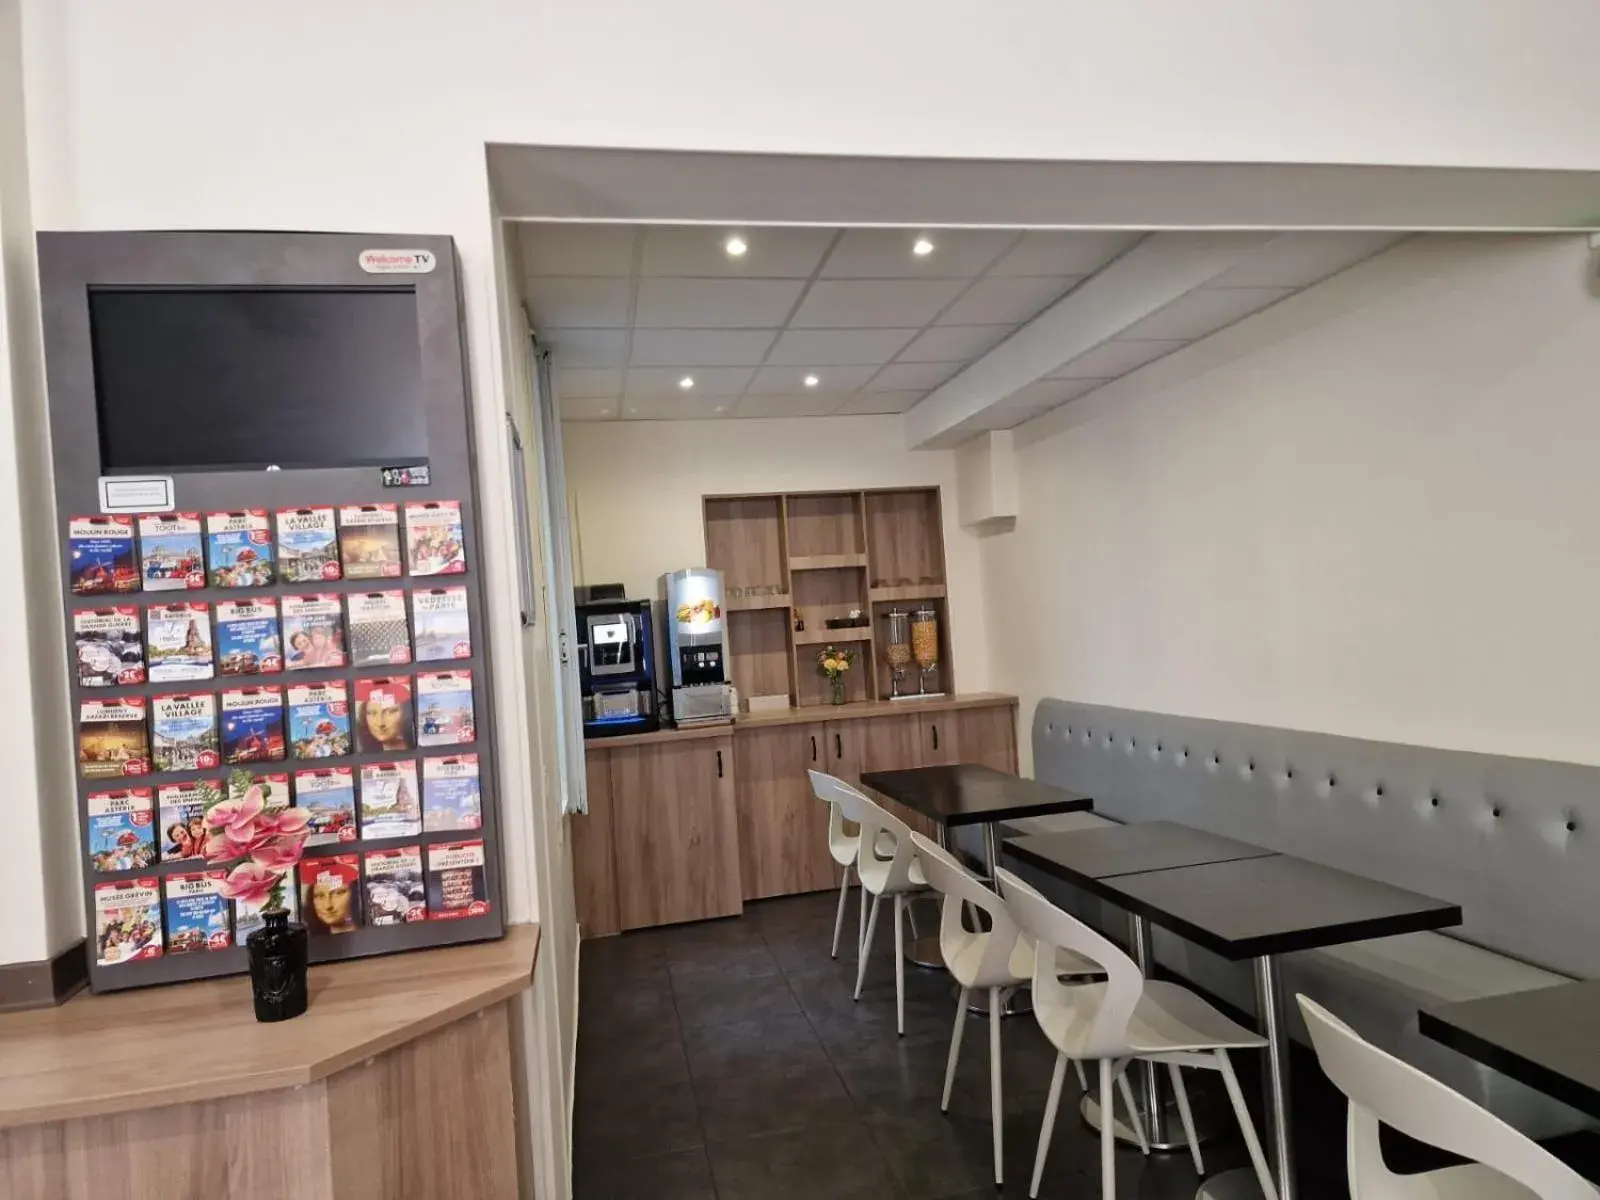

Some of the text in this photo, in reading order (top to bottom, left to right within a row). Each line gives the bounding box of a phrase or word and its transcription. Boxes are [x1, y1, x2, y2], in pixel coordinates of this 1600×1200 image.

[414, 255, 430, 263] TV
[289, 521, 325, 531] VILLAGE
[246, 606, 263, 614] BUS
[161, 704, 172, 712] LA
[165, 708, 203, 718] VILLAGE
[105, 805, 134, 813] ASTERIX
[180, 883, 194, 891] BIG
